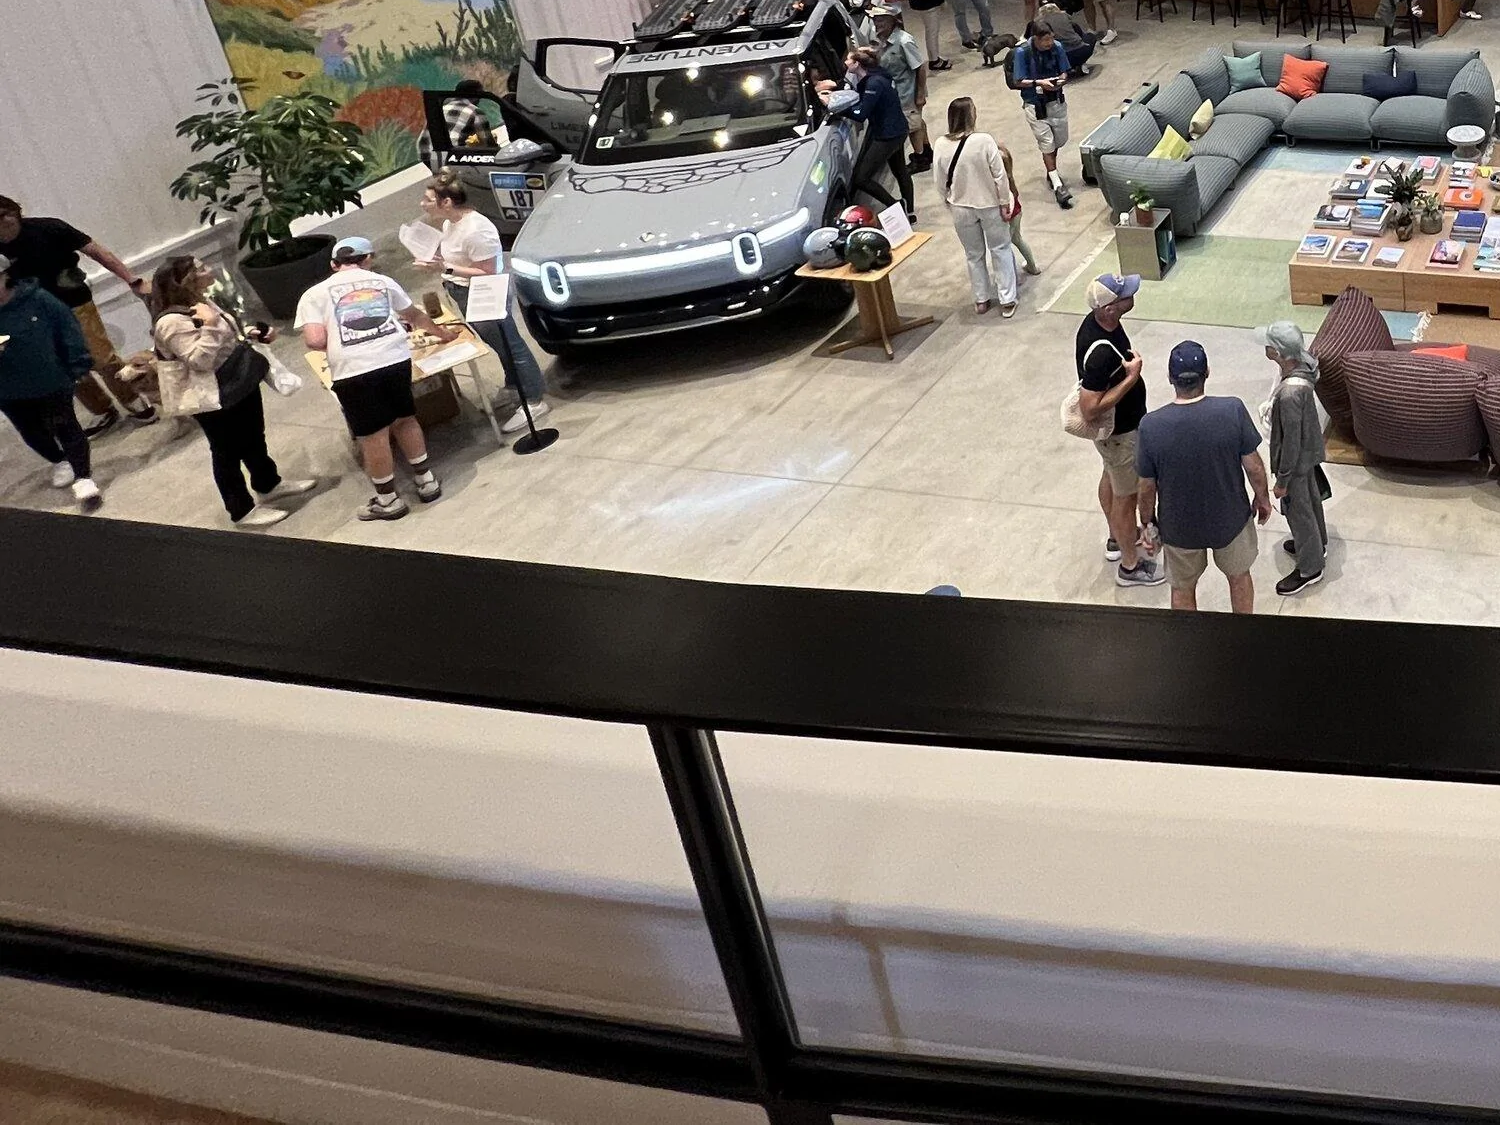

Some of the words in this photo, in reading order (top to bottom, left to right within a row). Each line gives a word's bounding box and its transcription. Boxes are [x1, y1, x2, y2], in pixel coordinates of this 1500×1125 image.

[626, 40, 791, 64] ADVENTURE
[447, 154, 459, 163] A.
[509, 190, 534, 207] 187
